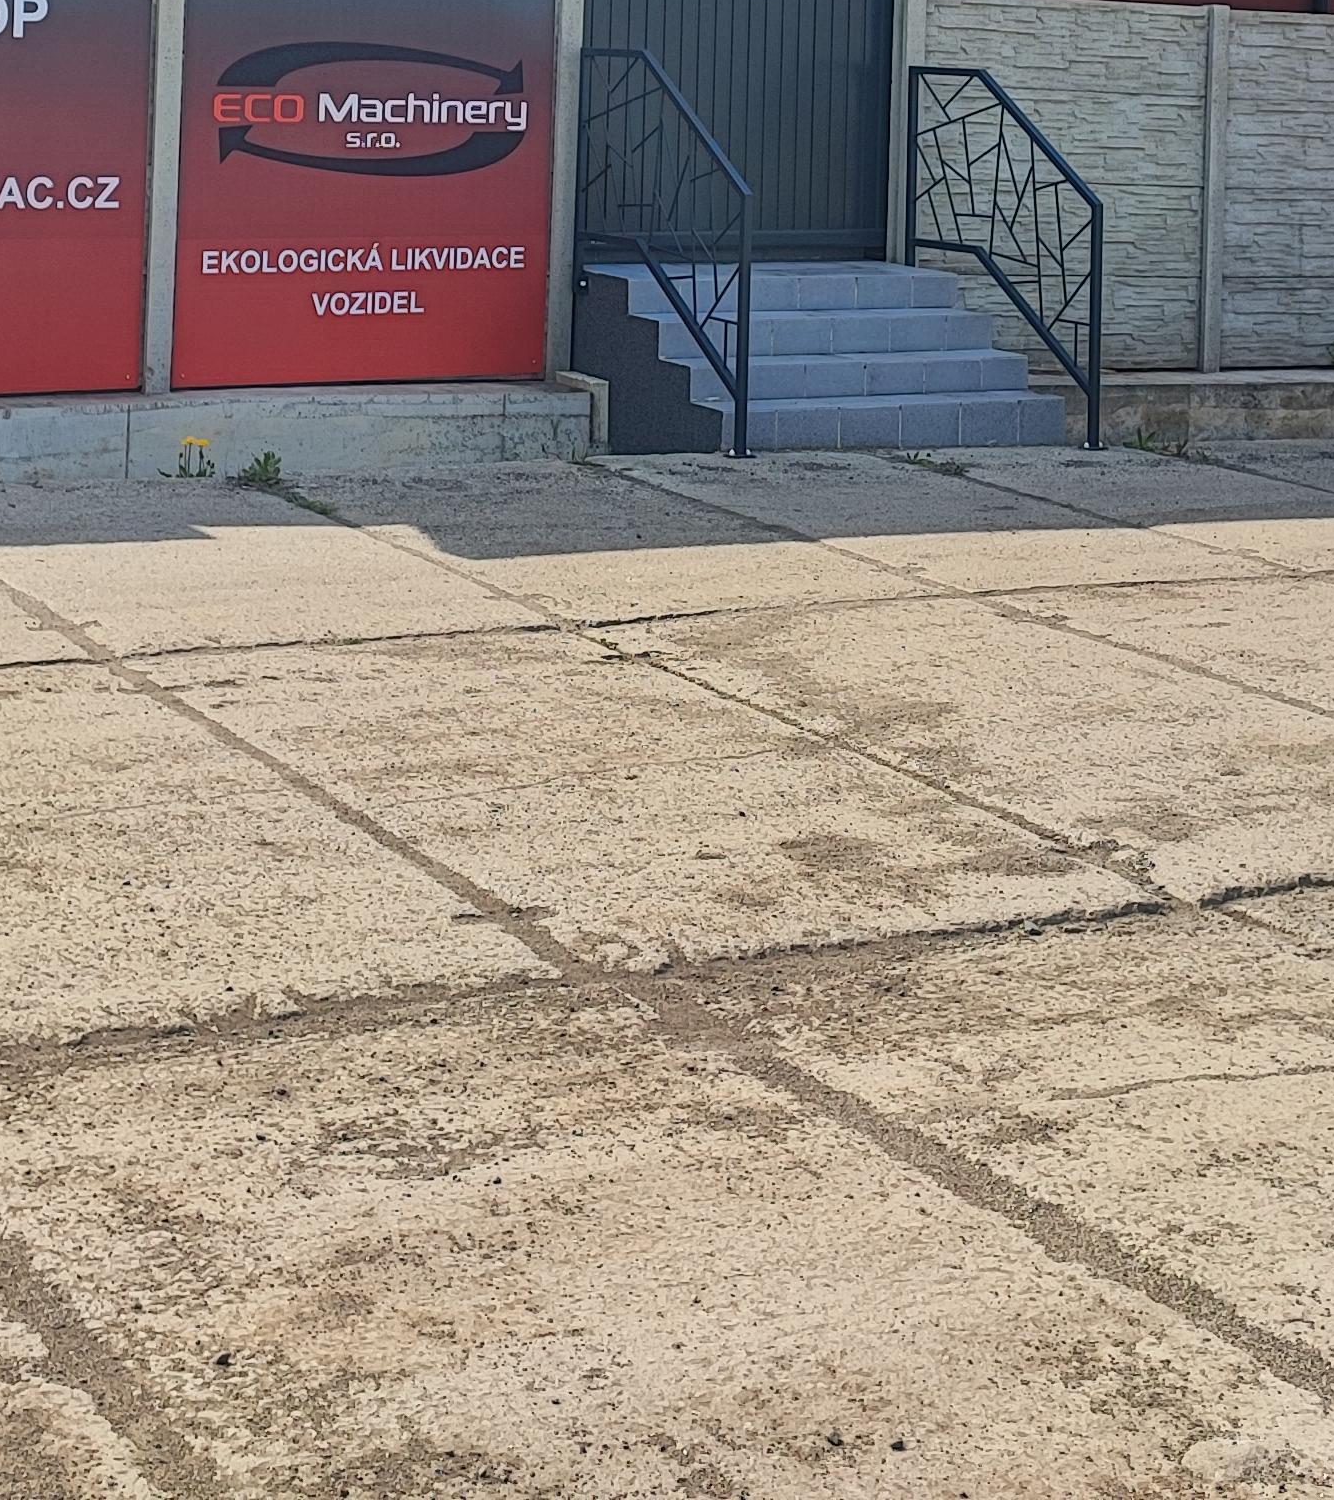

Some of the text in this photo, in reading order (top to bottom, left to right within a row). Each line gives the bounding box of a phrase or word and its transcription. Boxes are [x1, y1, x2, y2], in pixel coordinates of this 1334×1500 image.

[213, 92, 528, 131] ECO Machinery
[345, 132, 401, 149] s.r.o.
[202, 242, 525, 274] EKOLOGICKÁ LIKVIDACE
[311, 291, 425, 316] VOZIDEL
